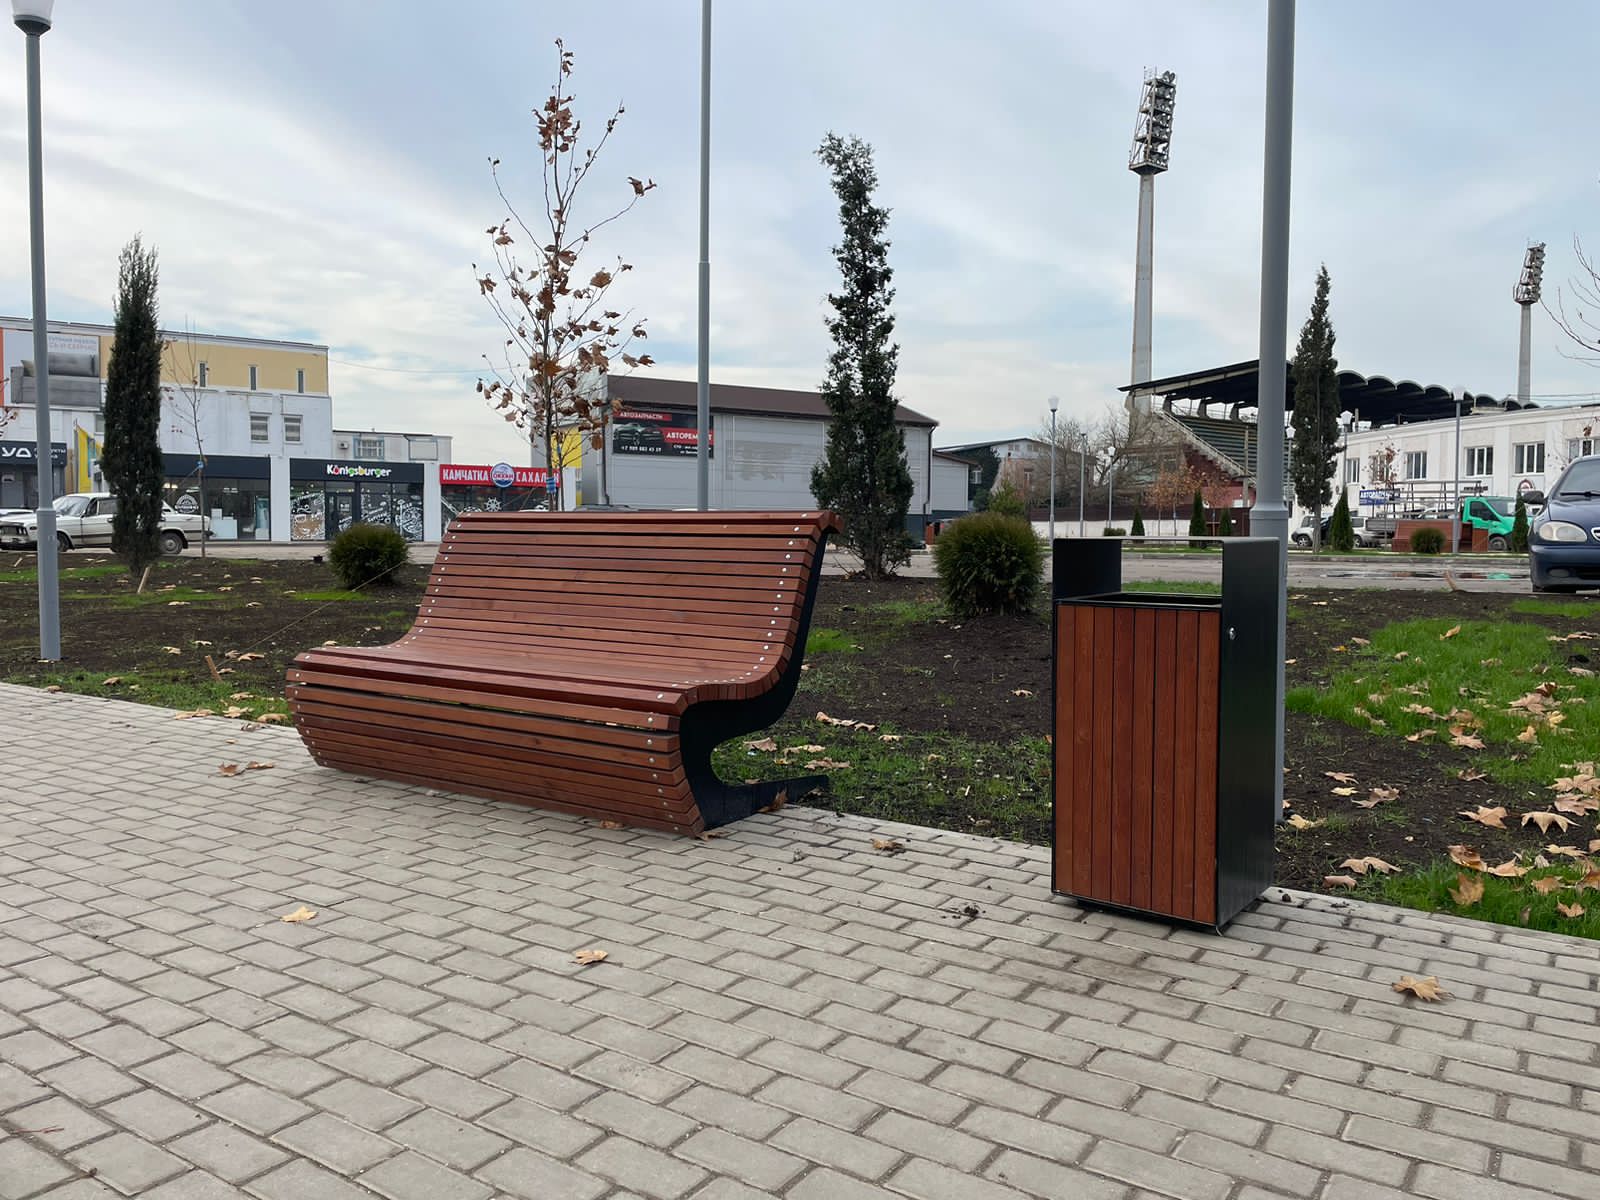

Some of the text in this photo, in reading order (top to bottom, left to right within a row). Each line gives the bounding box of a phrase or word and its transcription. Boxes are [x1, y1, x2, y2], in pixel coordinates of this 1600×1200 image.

[619, 412, 663, 420] АВТОЗАПЧАСТИ
[666, 431, 712, 441] АВТОРЕМТ
[326, 463, 392, 478] Königsburger
[442, 468, 560, 483] КАМЧАТКА САХАЛН
